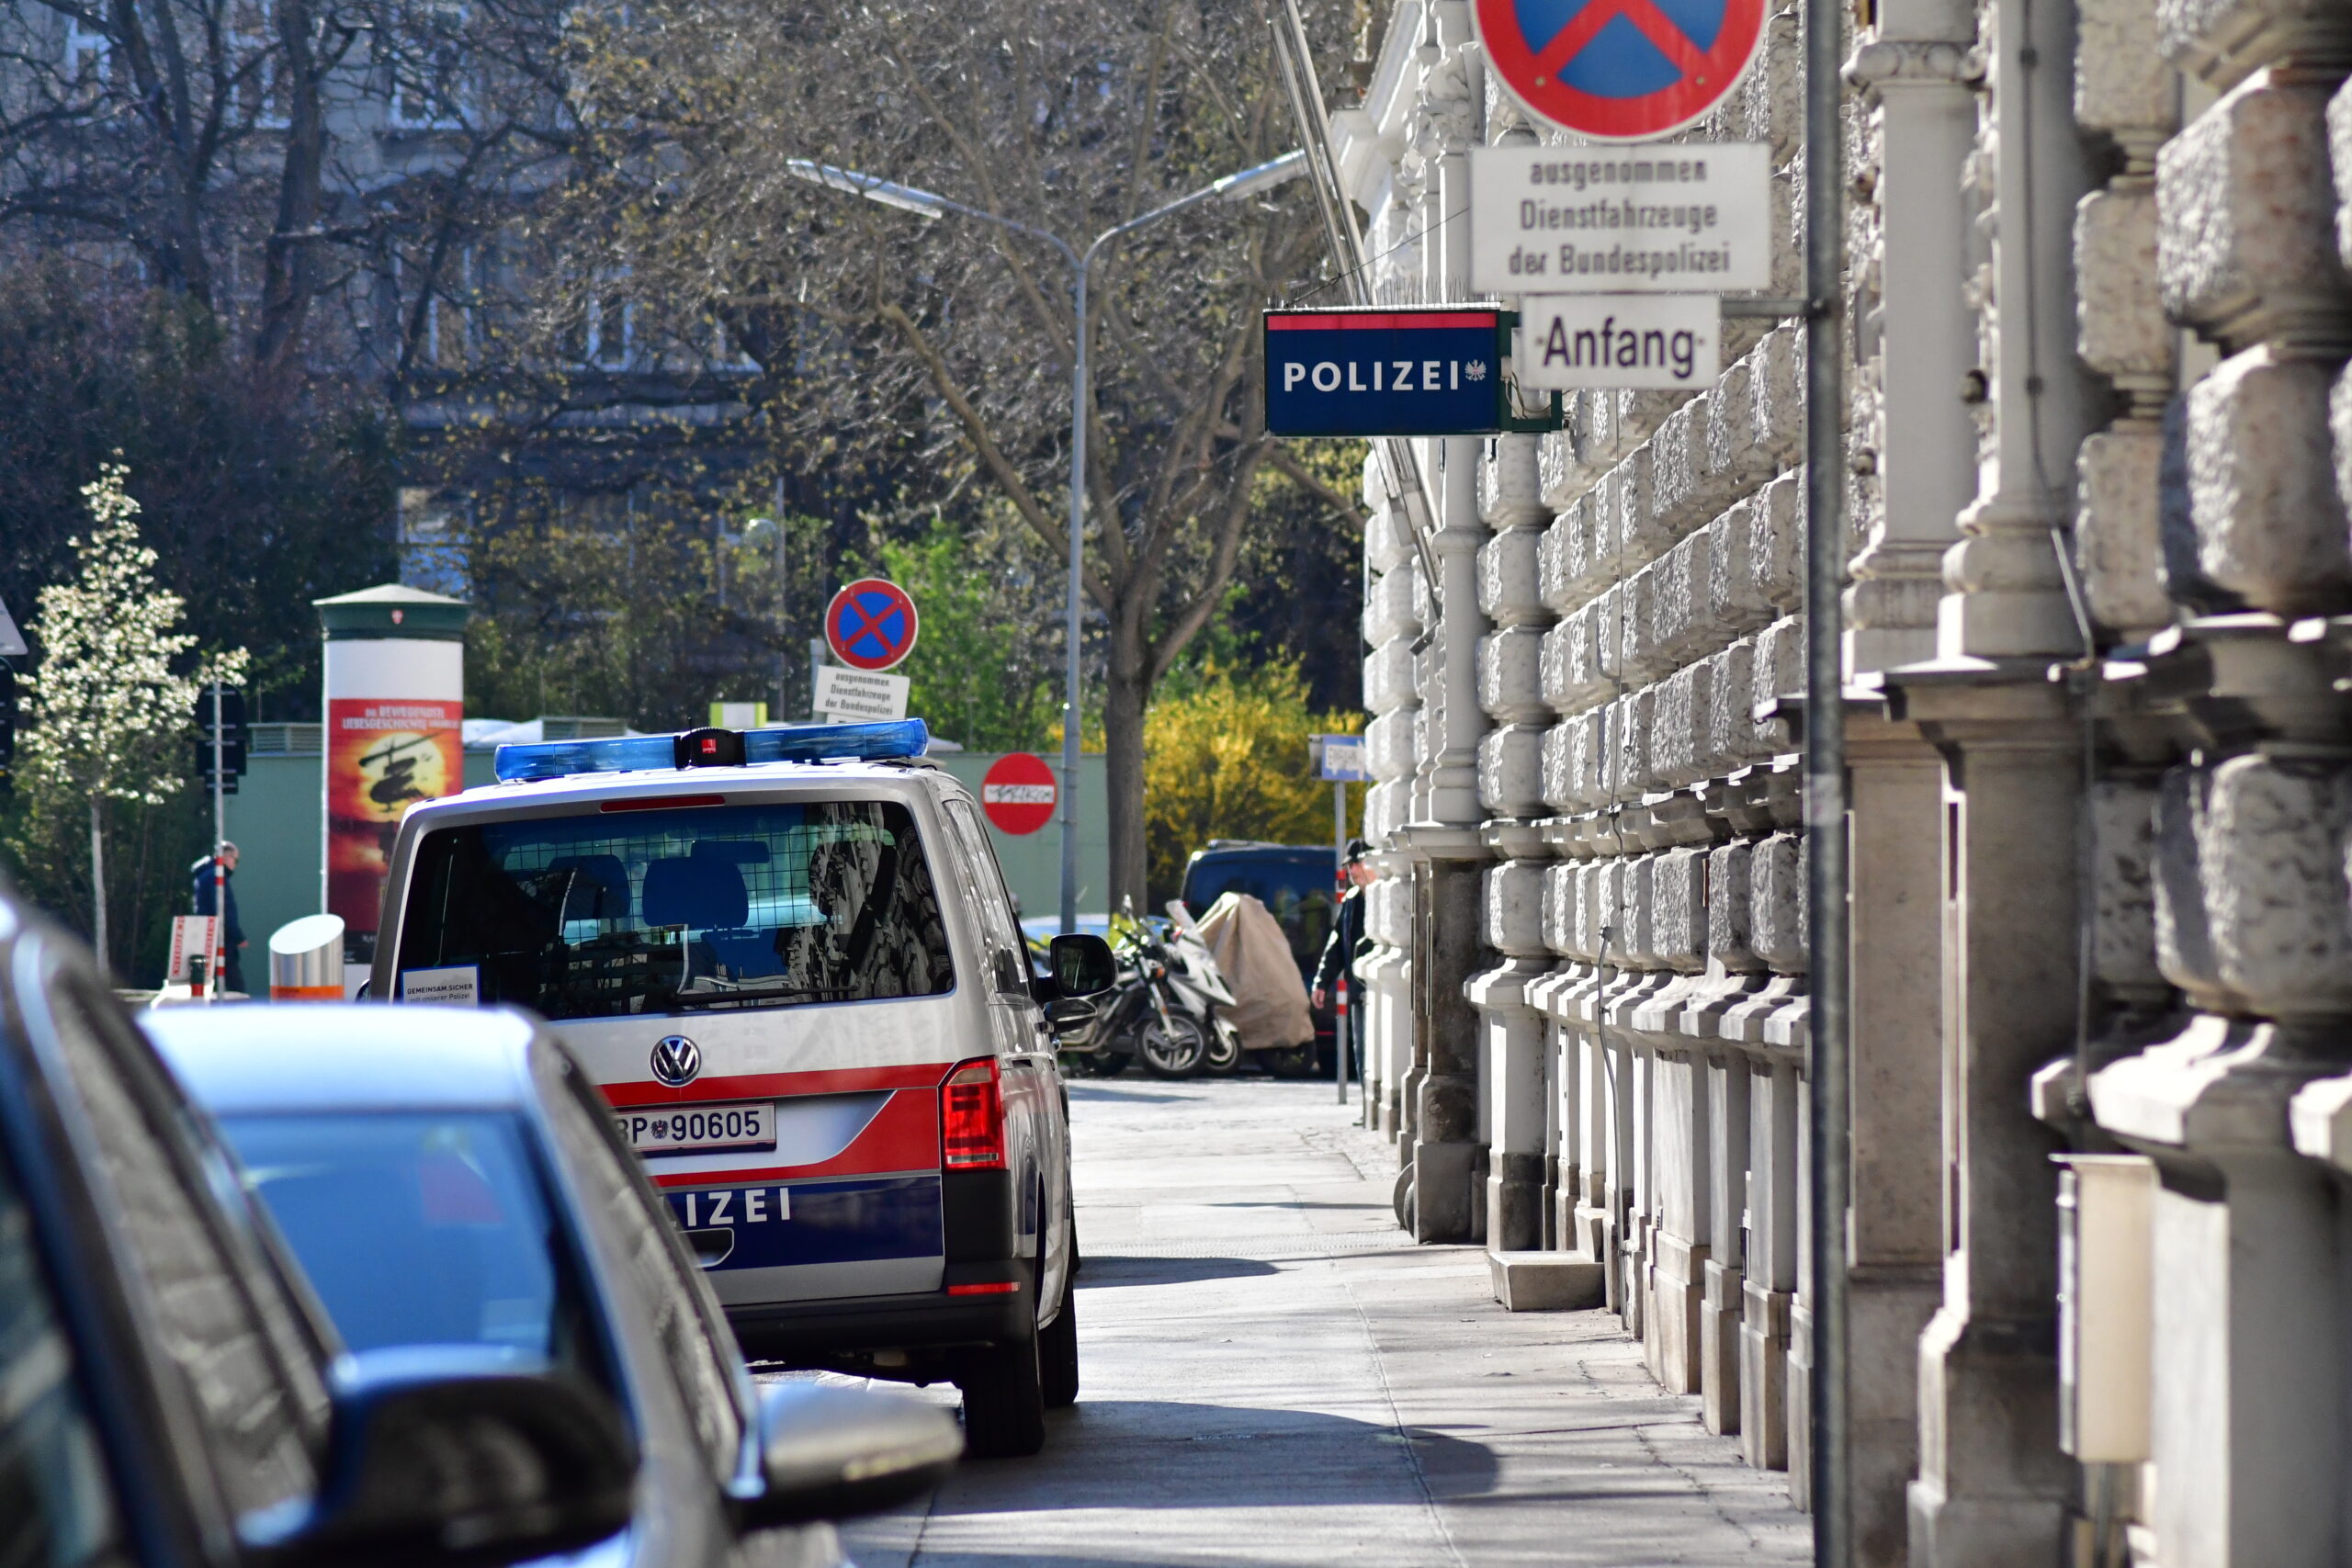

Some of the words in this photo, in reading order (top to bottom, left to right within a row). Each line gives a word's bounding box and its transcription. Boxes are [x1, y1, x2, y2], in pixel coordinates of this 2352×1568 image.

[1530, 160, 1707, 191] ausgenommen
[1521, 198, 1718, 234] Dienstfahrzeuge
[1509, 244, 1547, 275] der
[1560, 242, 1731, 280] Bundespolizei
[1543, 316, 1695, 379] Anfang
[1283, 360, 1459, 393] POLIZEI
[831, 683, 891, 703] Dienstfahrzeuge
[835, 672, 890, 687] ausgenommen
[825, 697, 838, 708] der
[840, 698, 893, 715] Bundespolizei
[449, 992, 470, 1000] Polizei
[671, 1110, 760, 1141] 90605
[669, 1188, 791, 1229] IZEI
